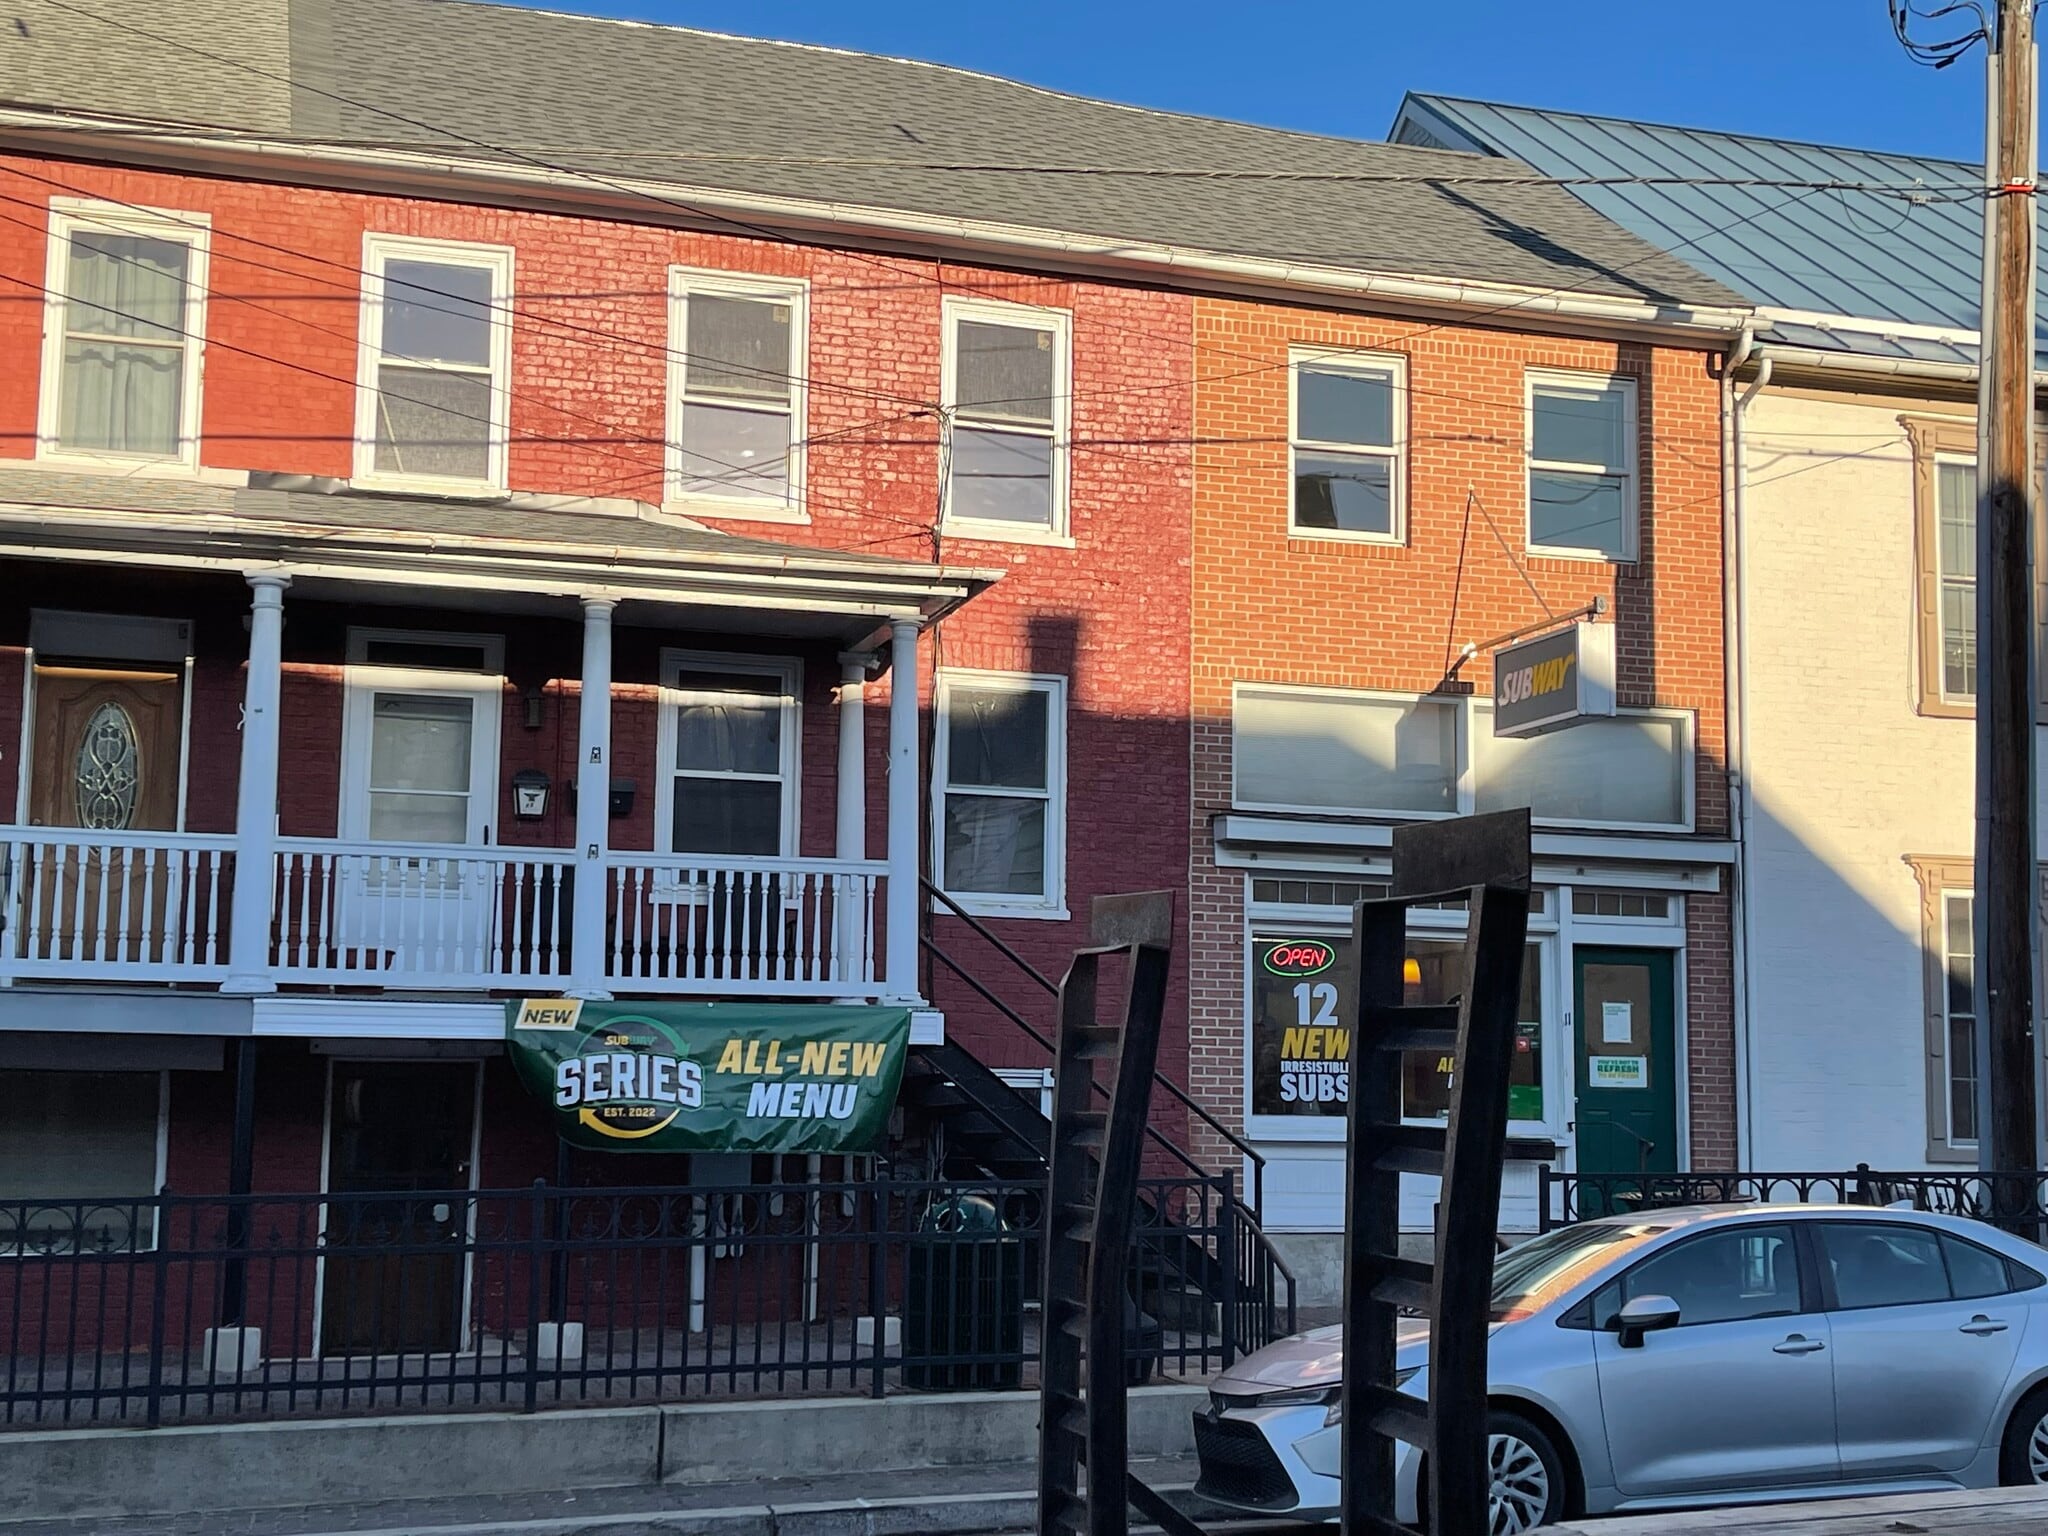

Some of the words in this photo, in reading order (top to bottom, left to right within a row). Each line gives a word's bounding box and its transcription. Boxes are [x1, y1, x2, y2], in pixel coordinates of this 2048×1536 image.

[1498, 653, 1575, 706] SUBWAY
[1272, 948, 1326, 967] OPEN
[524, 1009, 574, 1024] NEW
[1293, 983, 1338, 1026] 12
[604, 1035, 657, 1046] SUBWAY
[1280, 1027, 1350, 1060] NEW
[716, 1039, 887, 1077] ALL-NEW
[556, 1053, 702, 1107] SERIES
[1280, 1074, 1349, 1103] SUBS
[604, 1108, 626, 1118] EST.
[629, 1107, 656, 1118] 2022
[746, 1082, 858, 1119] MENU
